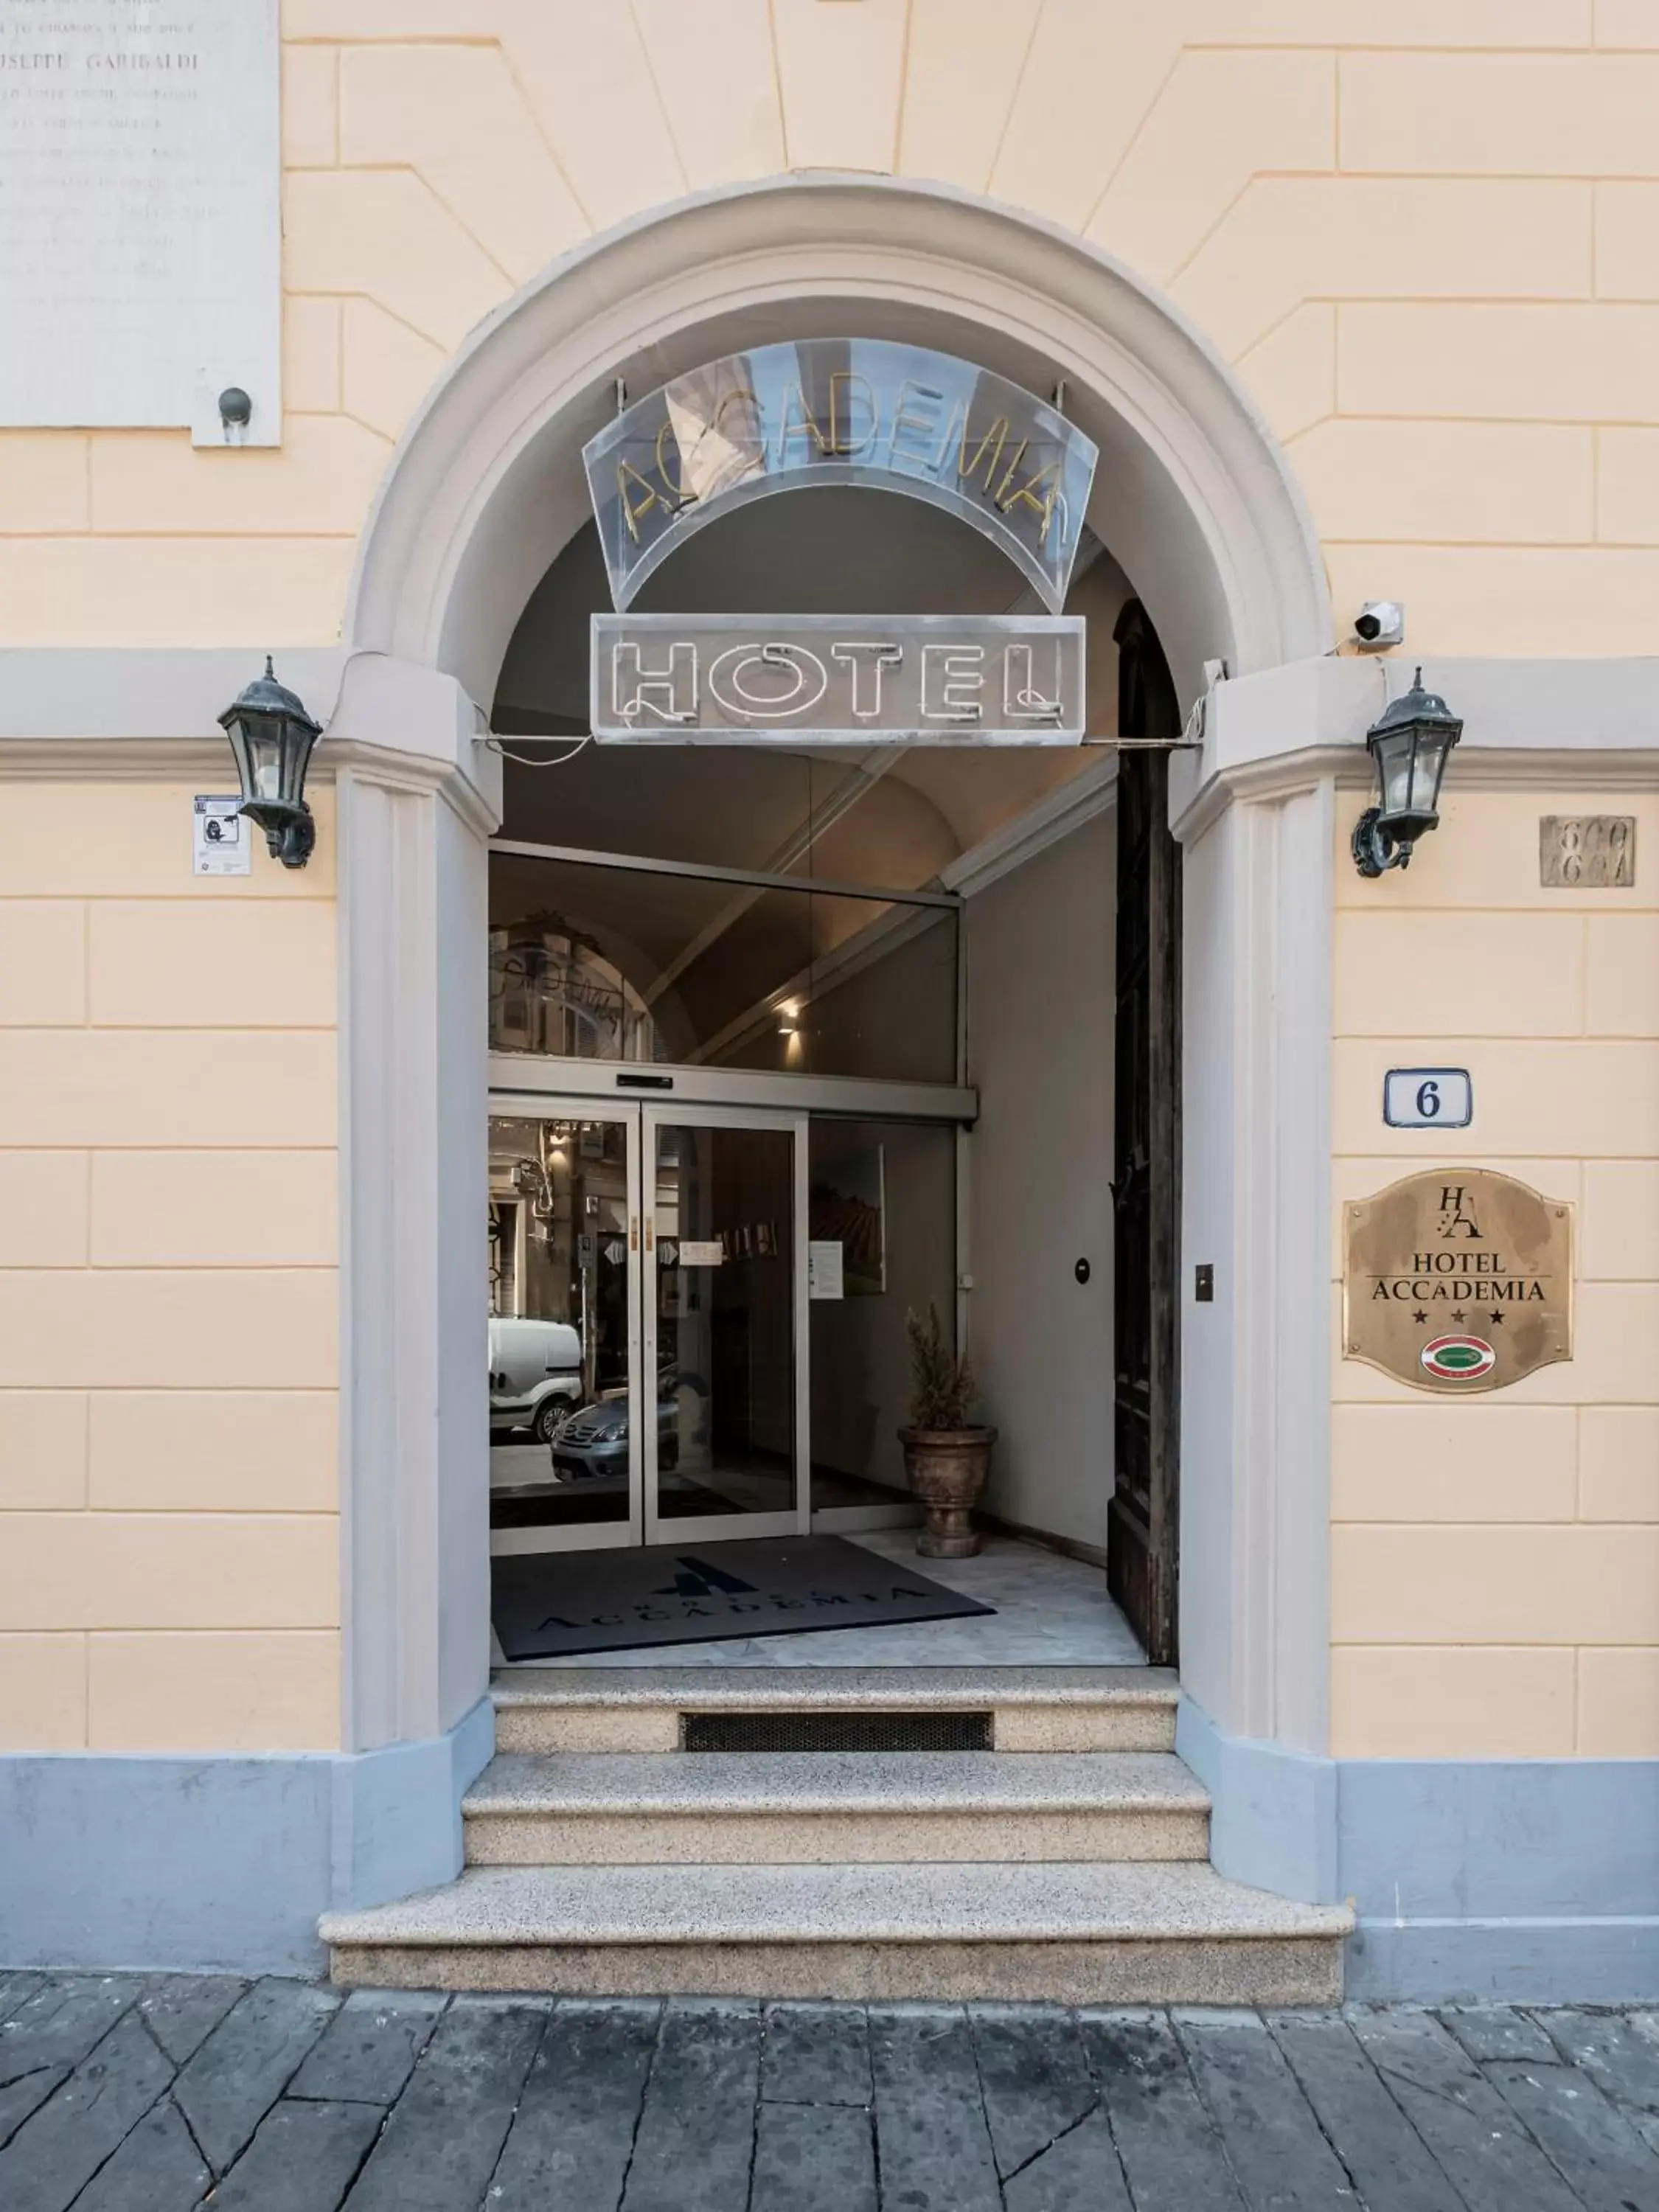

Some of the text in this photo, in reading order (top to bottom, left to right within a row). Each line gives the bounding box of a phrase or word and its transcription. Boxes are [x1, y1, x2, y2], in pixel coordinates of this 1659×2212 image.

[86, 52, 198, 70] GARIBALDI
[616, 372, 1067, 549] ACCADEMIA
[612, 642, 1063, 720] HOTEL
[1416, 1080, 1440, 1118] 6
[1412, 1253, 1506, 1273] HOTEL
[1371, 1280, 1545, 1301] ACCADEMIA
[531, 1587, 933, 1632] ACCADEMIA
